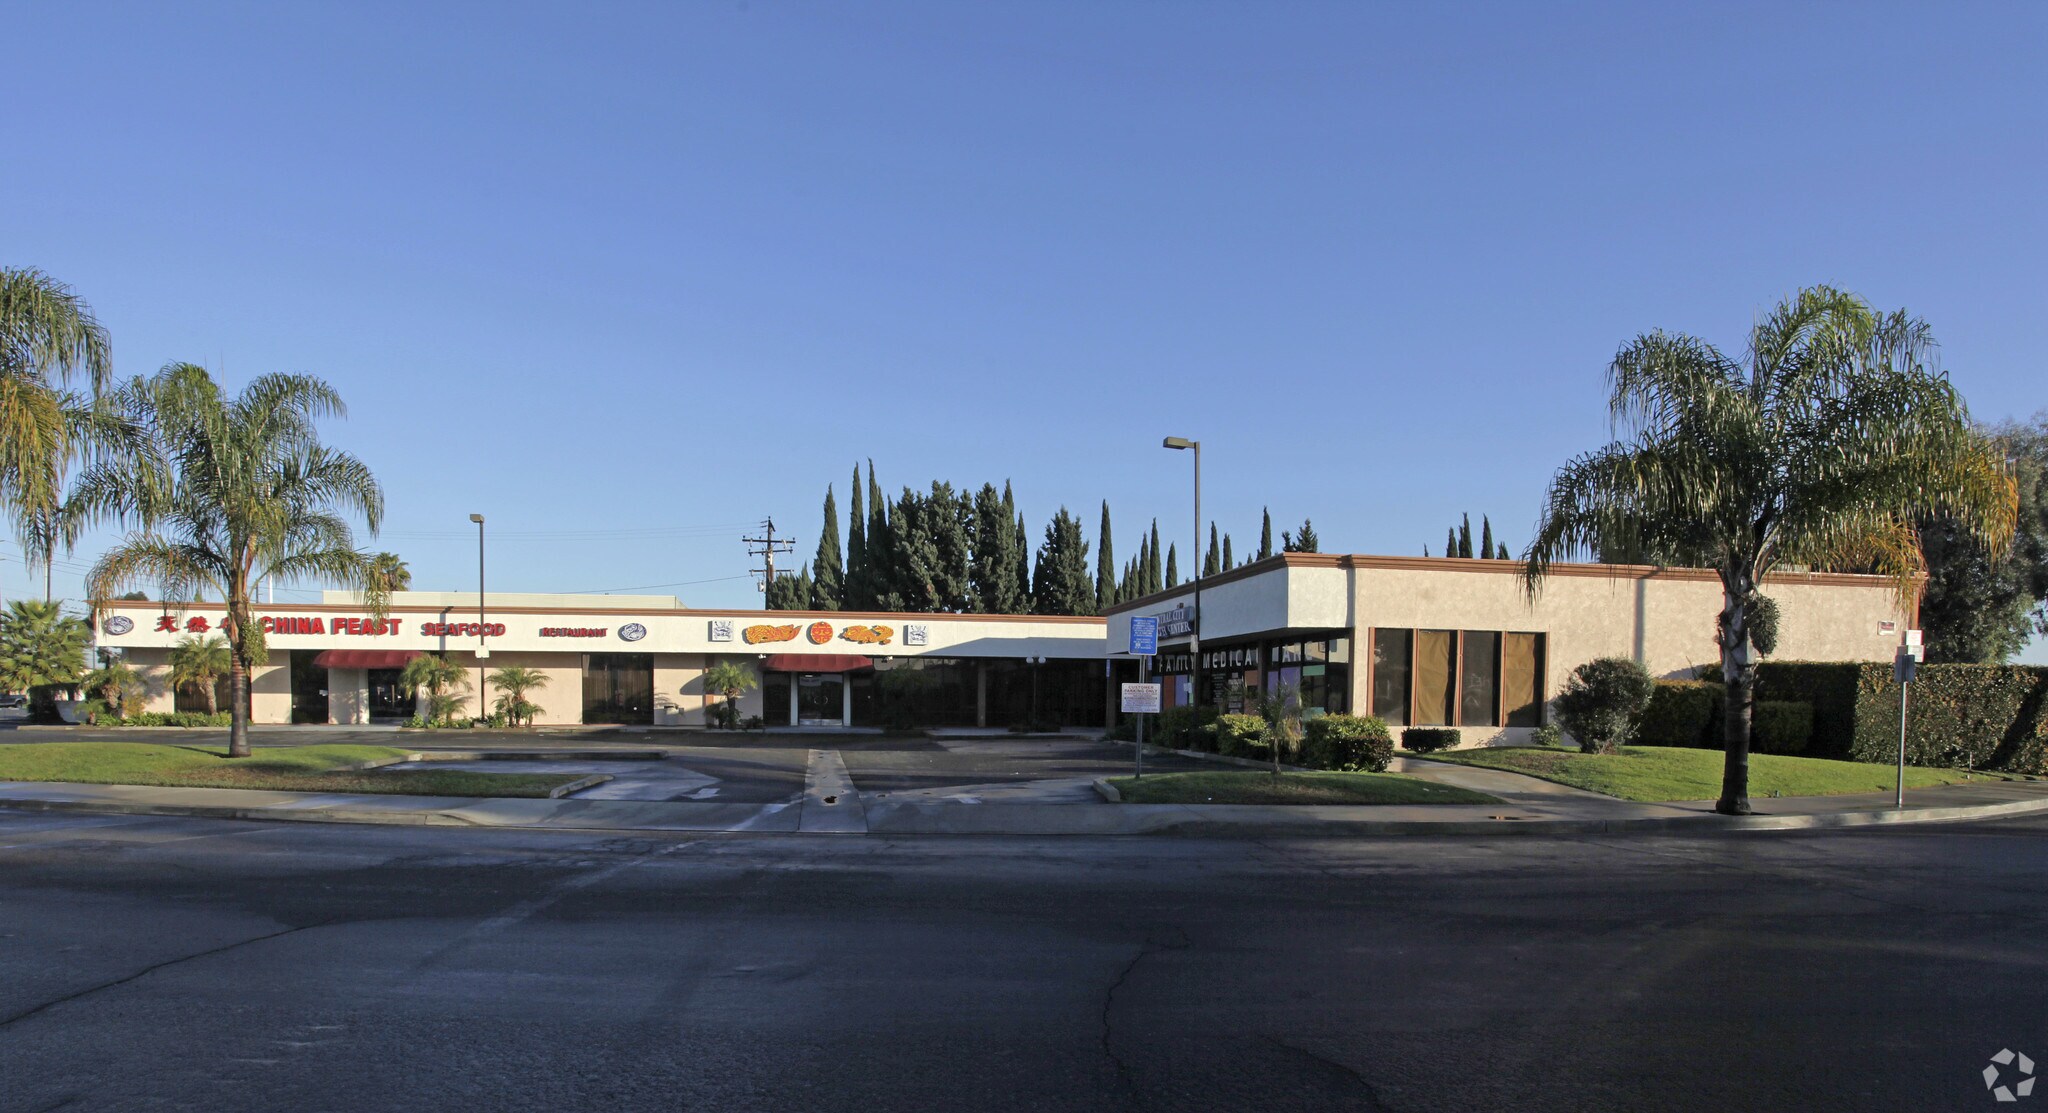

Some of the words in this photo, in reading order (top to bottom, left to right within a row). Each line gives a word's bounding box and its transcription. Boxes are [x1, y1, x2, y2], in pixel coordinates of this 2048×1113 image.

[154, 615, 229, 633] 天然
[259, 616, 326, 635] CHINA
[331, 617, 402, 636] FEAST
[422, 622, 506, 637] SEAFOOD
[1167, 621, 1192, 635] CENTER
[541, 627, 608, 638] RESTAURANT
